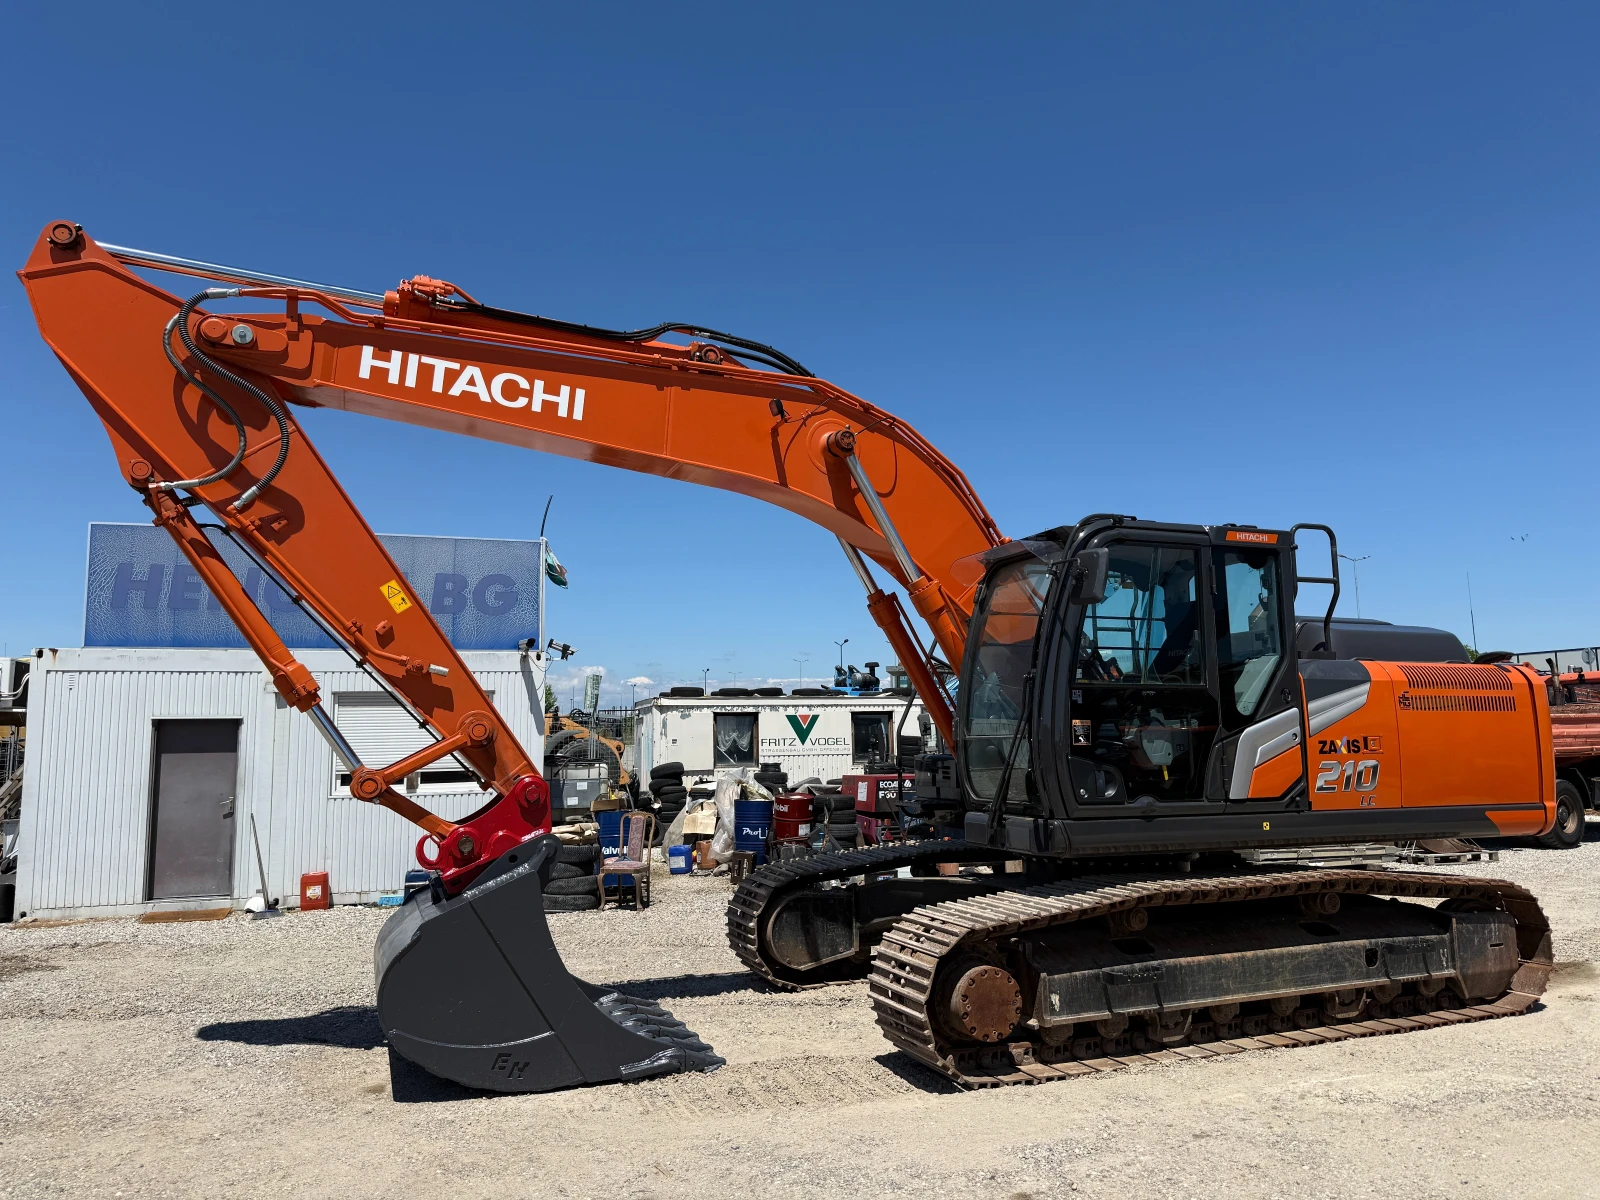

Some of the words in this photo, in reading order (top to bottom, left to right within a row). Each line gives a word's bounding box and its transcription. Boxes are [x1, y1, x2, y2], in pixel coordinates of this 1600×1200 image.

[358, 345, 586, 420] HITACHI
[1236, 532, 1268, 541] HITACHI
[430, 572, 518, 616] BG
[761, 737, 797, 747] FRITZ
[809, 737, 850, 746] VOGEL
[1318, 736, 1361, 754] ZAXIS
[1315, 760, 1380, 793] 210
[1360, 795, 1377, 807] LC
[742, 827, 769, 838] ProLi
